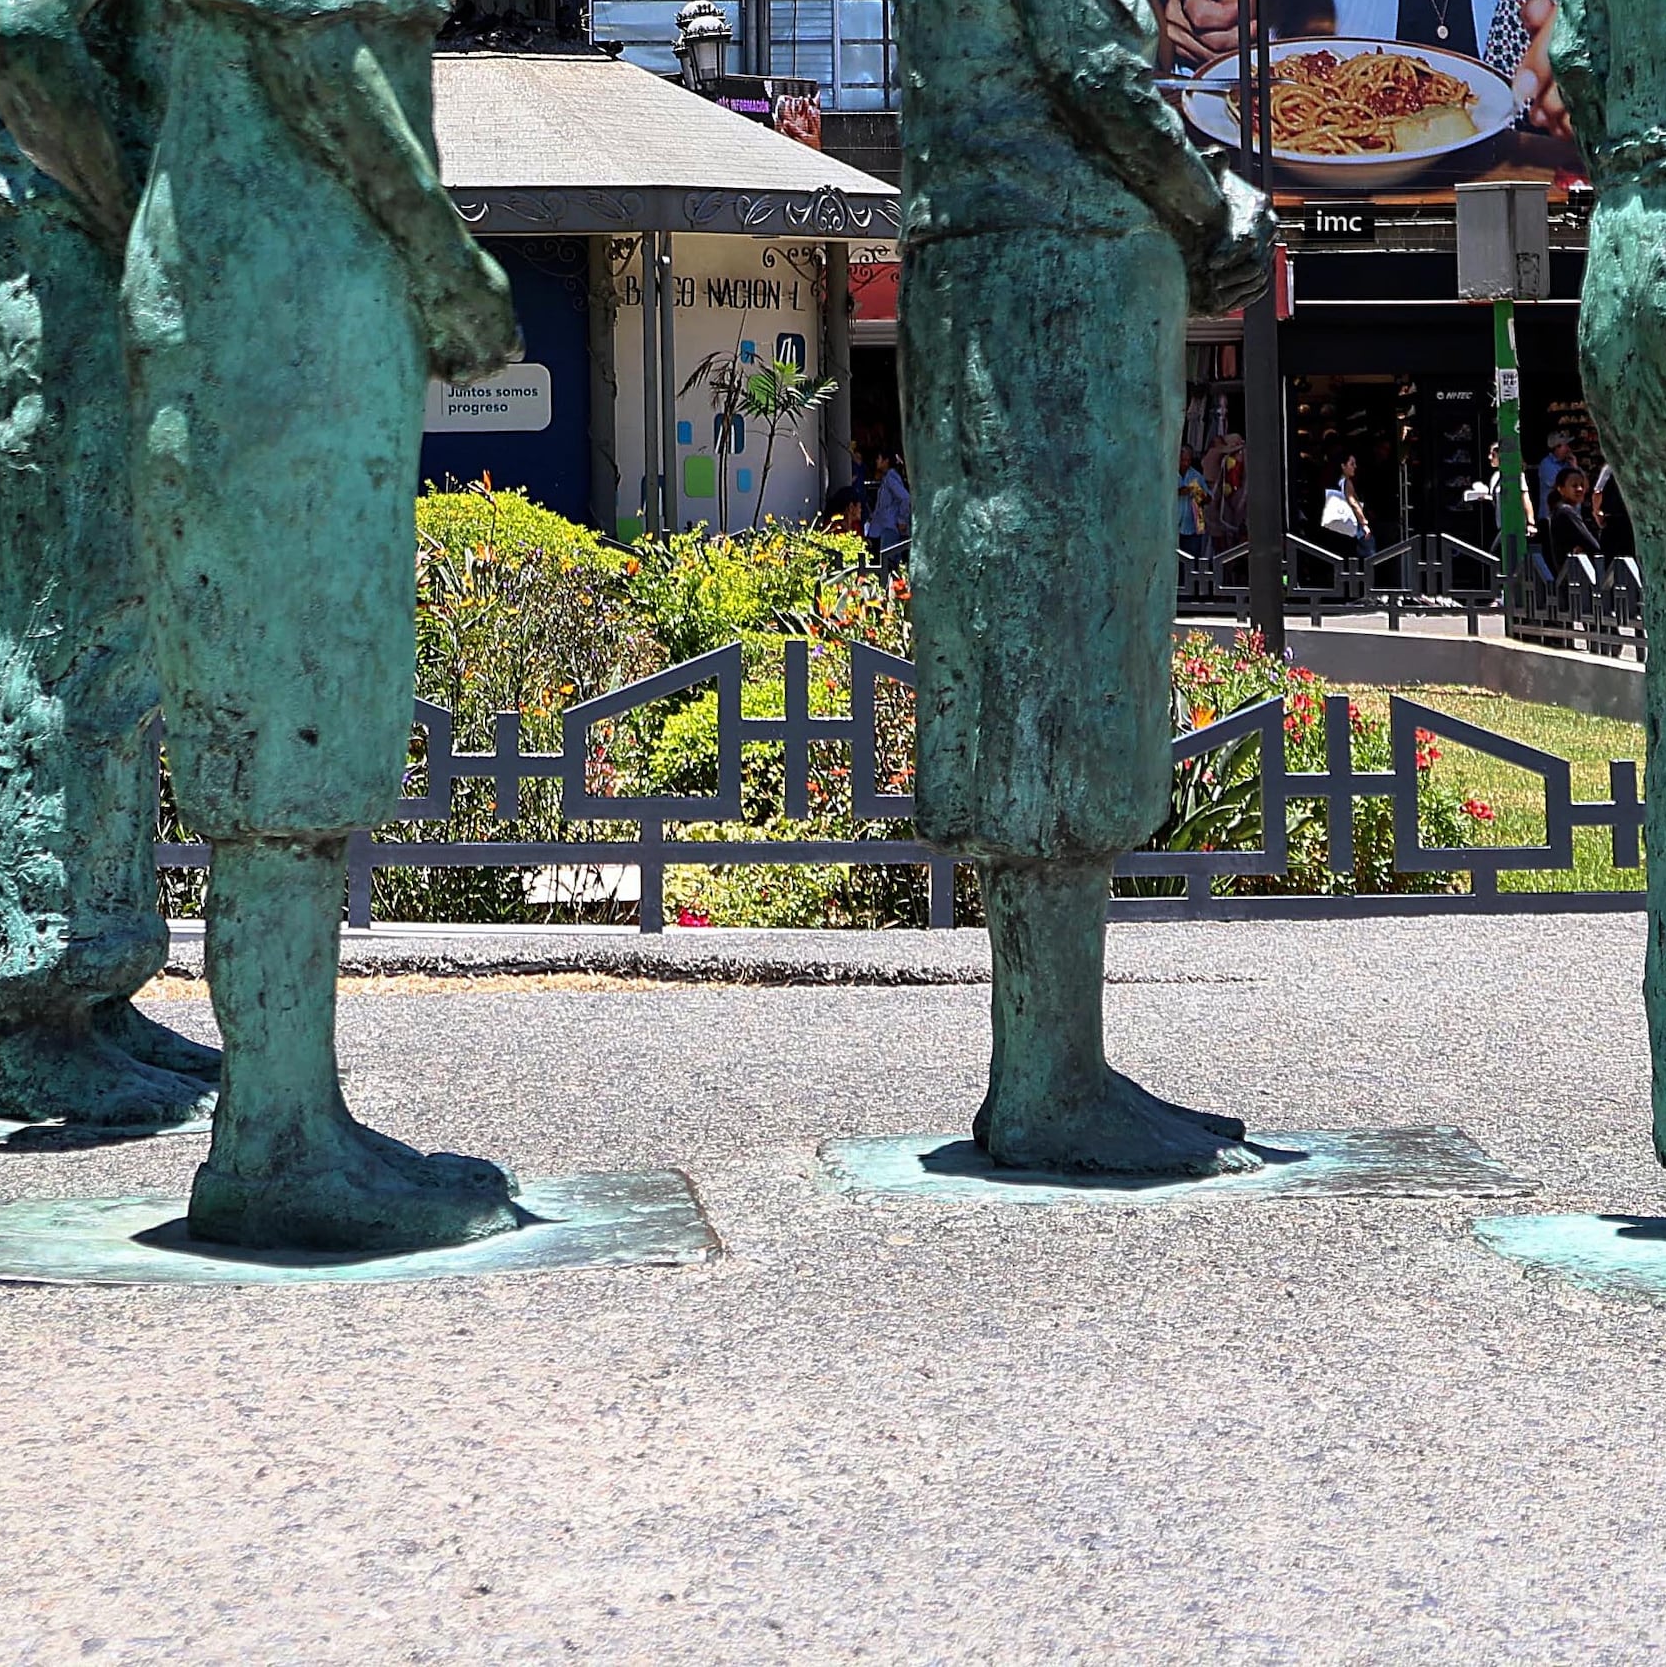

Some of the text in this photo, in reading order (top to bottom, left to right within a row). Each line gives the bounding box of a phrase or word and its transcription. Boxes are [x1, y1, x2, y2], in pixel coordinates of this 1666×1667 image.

[1316, 210, 1362, 232] imc
[448, 387, 539, 397] Juntos somos
[448, 403, 508, 415] progreso
